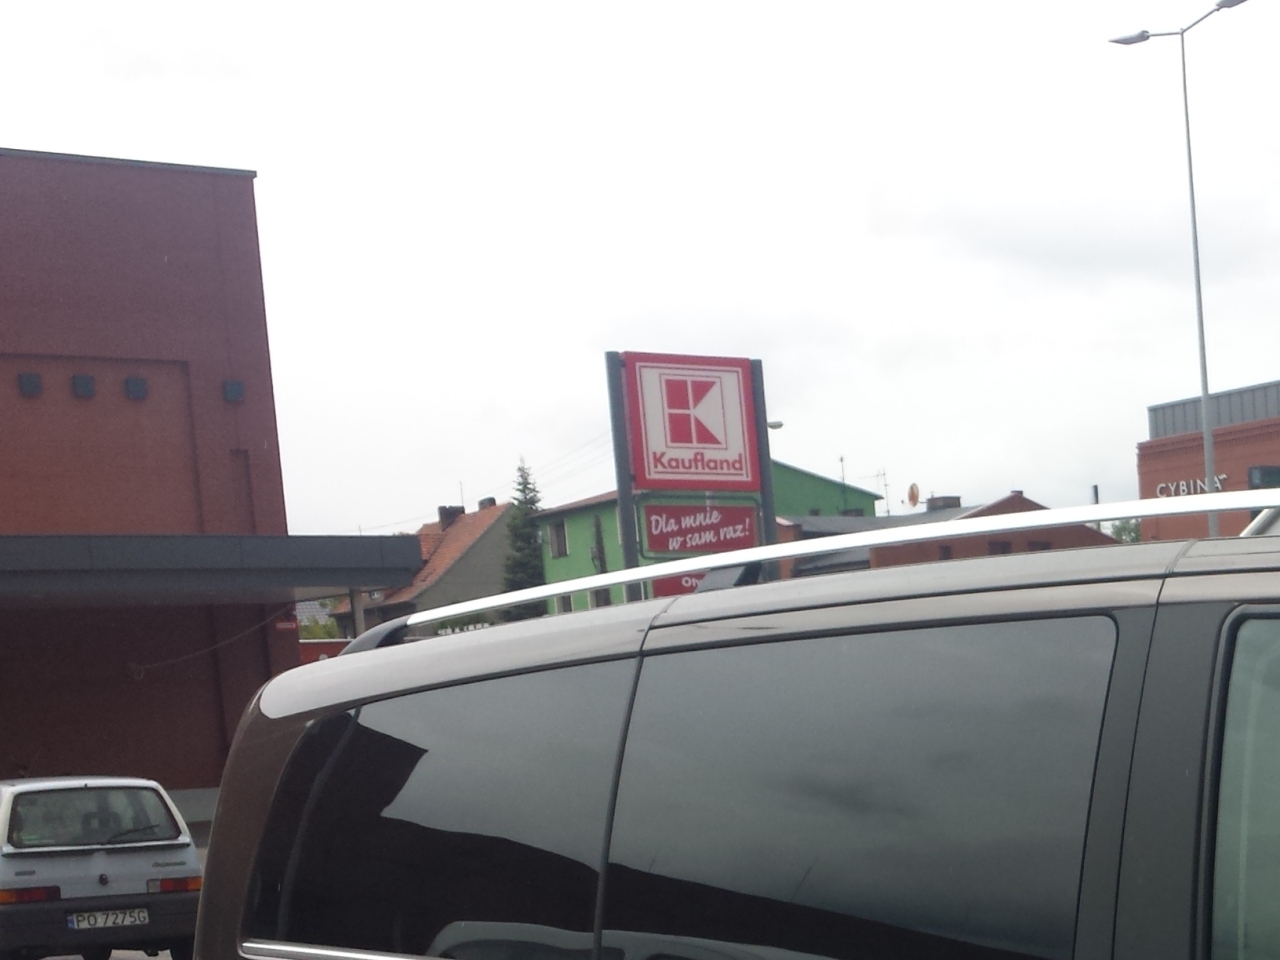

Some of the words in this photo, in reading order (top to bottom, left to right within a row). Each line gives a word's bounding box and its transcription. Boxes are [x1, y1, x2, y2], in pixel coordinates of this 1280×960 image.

[652, 451, 744, 472] Kaufland
[650, 514, 679, 535] Dla
[681, 507, 722, 529] mnie
[668, 536, 685, 551] w
[686, 530, 718, 548] sam
[719, 517, 750, 541] raz!
[75, 912, 98, 928] PO
[102, 909, 147, 927] 7275G
